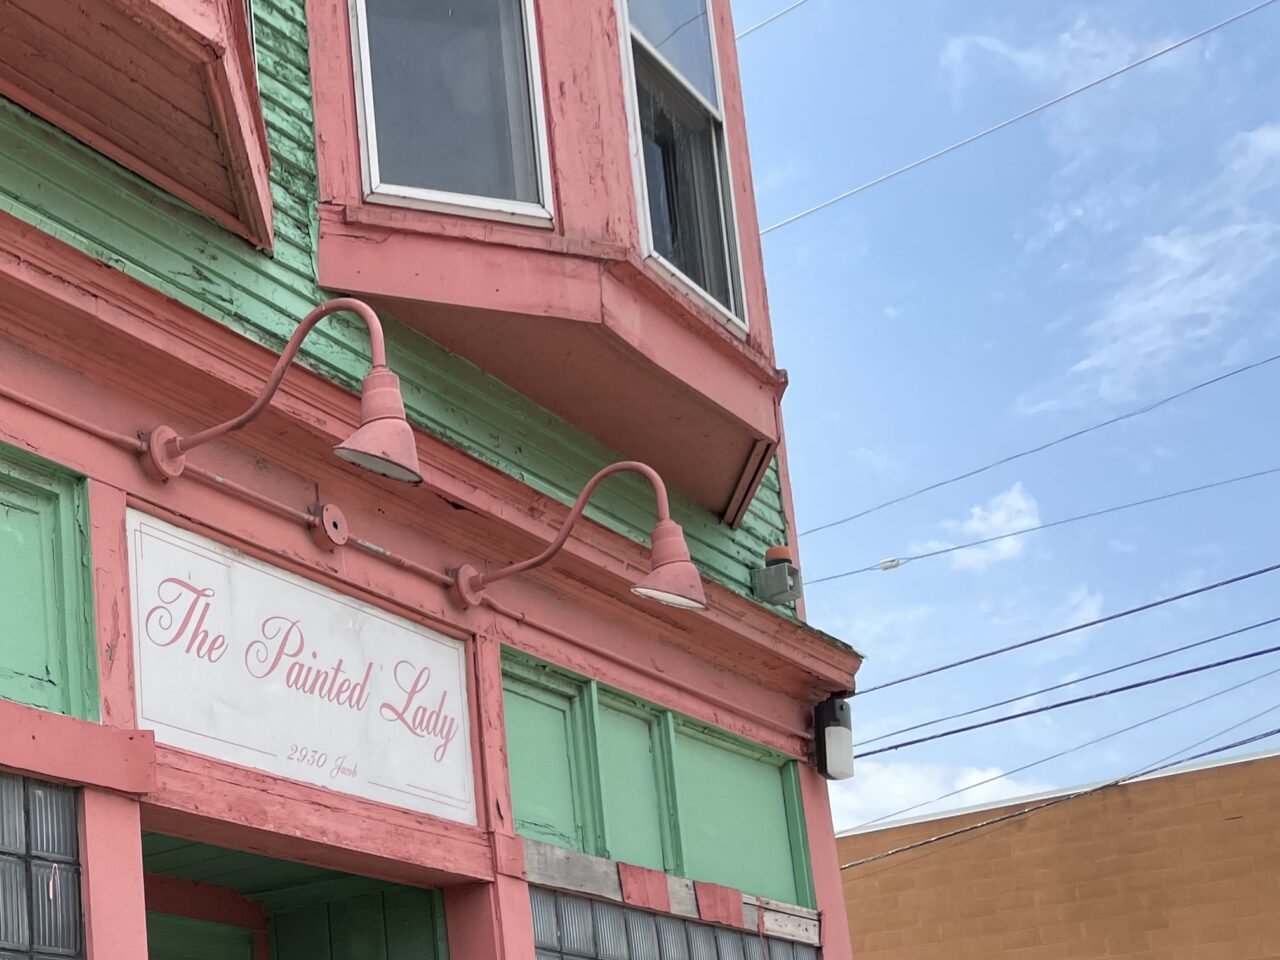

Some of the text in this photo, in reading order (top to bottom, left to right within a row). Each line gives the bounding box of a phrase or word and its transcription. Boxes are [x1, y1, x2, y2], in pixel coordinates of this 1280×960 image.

[145, 577, 458, 762] The Painted Lady
[287, 744, 328, 768] 2930
